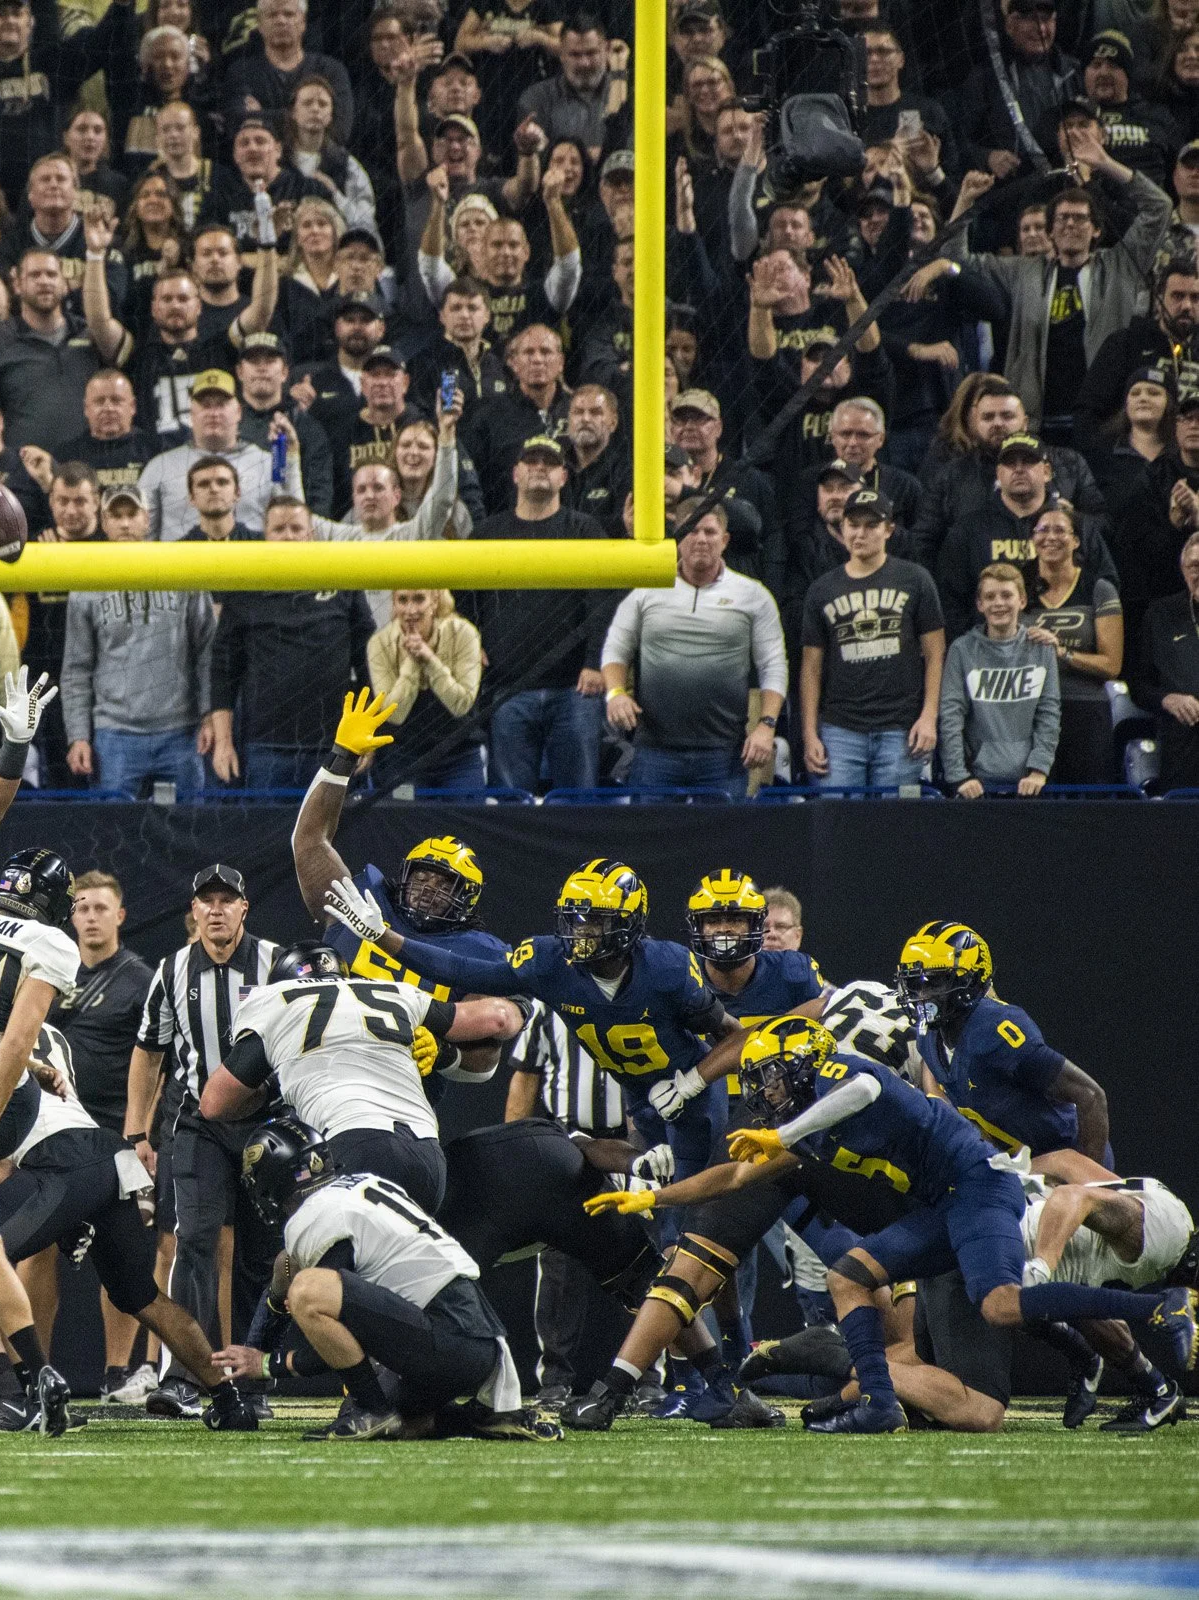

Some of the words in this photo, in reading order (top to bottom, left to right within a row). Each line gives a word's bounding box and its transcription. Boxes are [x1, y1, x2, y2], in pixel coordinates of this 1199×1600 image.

[823, 588, 910, 625] PURDUE
[27, 682, 45, 731] MICHIGAN
[974, 667, 1036, 700] NIKE
[326, 893, 381, 941] MICHIGAN
[189, 987, 199, 1001] S
[282, 984, 415, 1055] 75
[576, 1023, 671, 1076] 19
[818, 1060, 849, 1080] 5
[830, 1146, 911, 1194] 5
